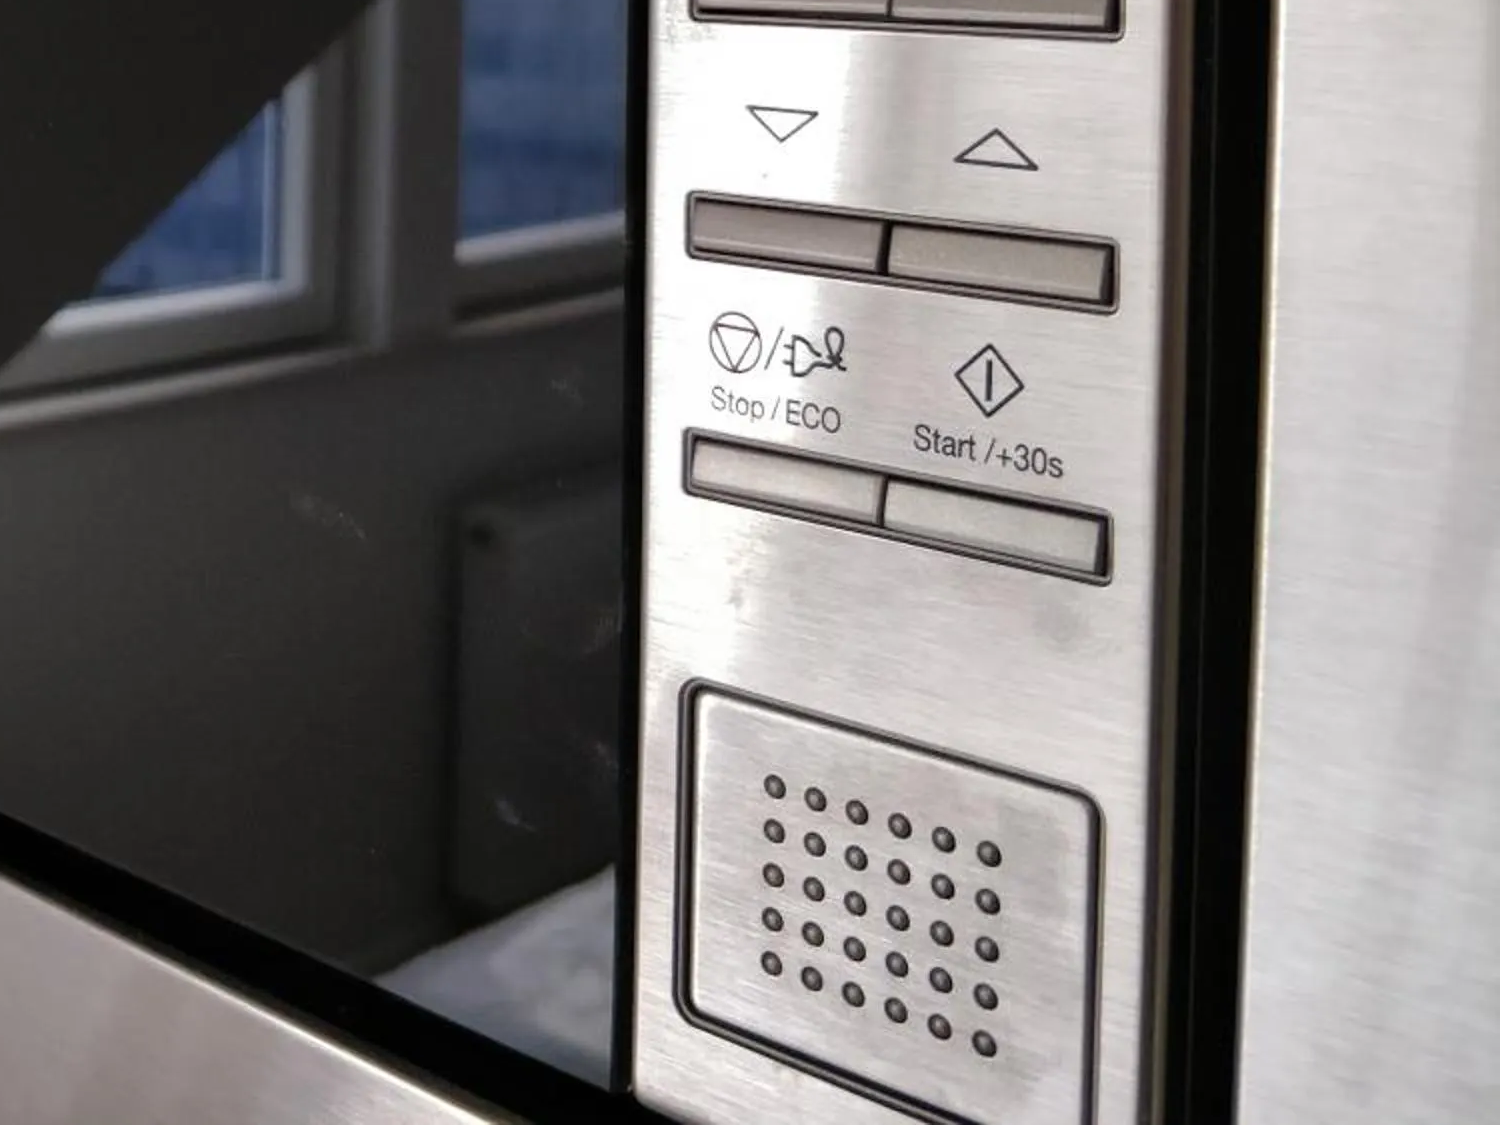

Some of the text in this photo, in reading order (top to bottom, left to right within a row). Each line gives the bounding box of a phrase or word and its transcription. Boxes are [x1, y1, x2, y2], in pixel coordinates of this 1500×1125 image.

[711, 386, 765, 422] Stop
[786, 401, 841, 434] ECO
[914, 424, 976, 463] Start
